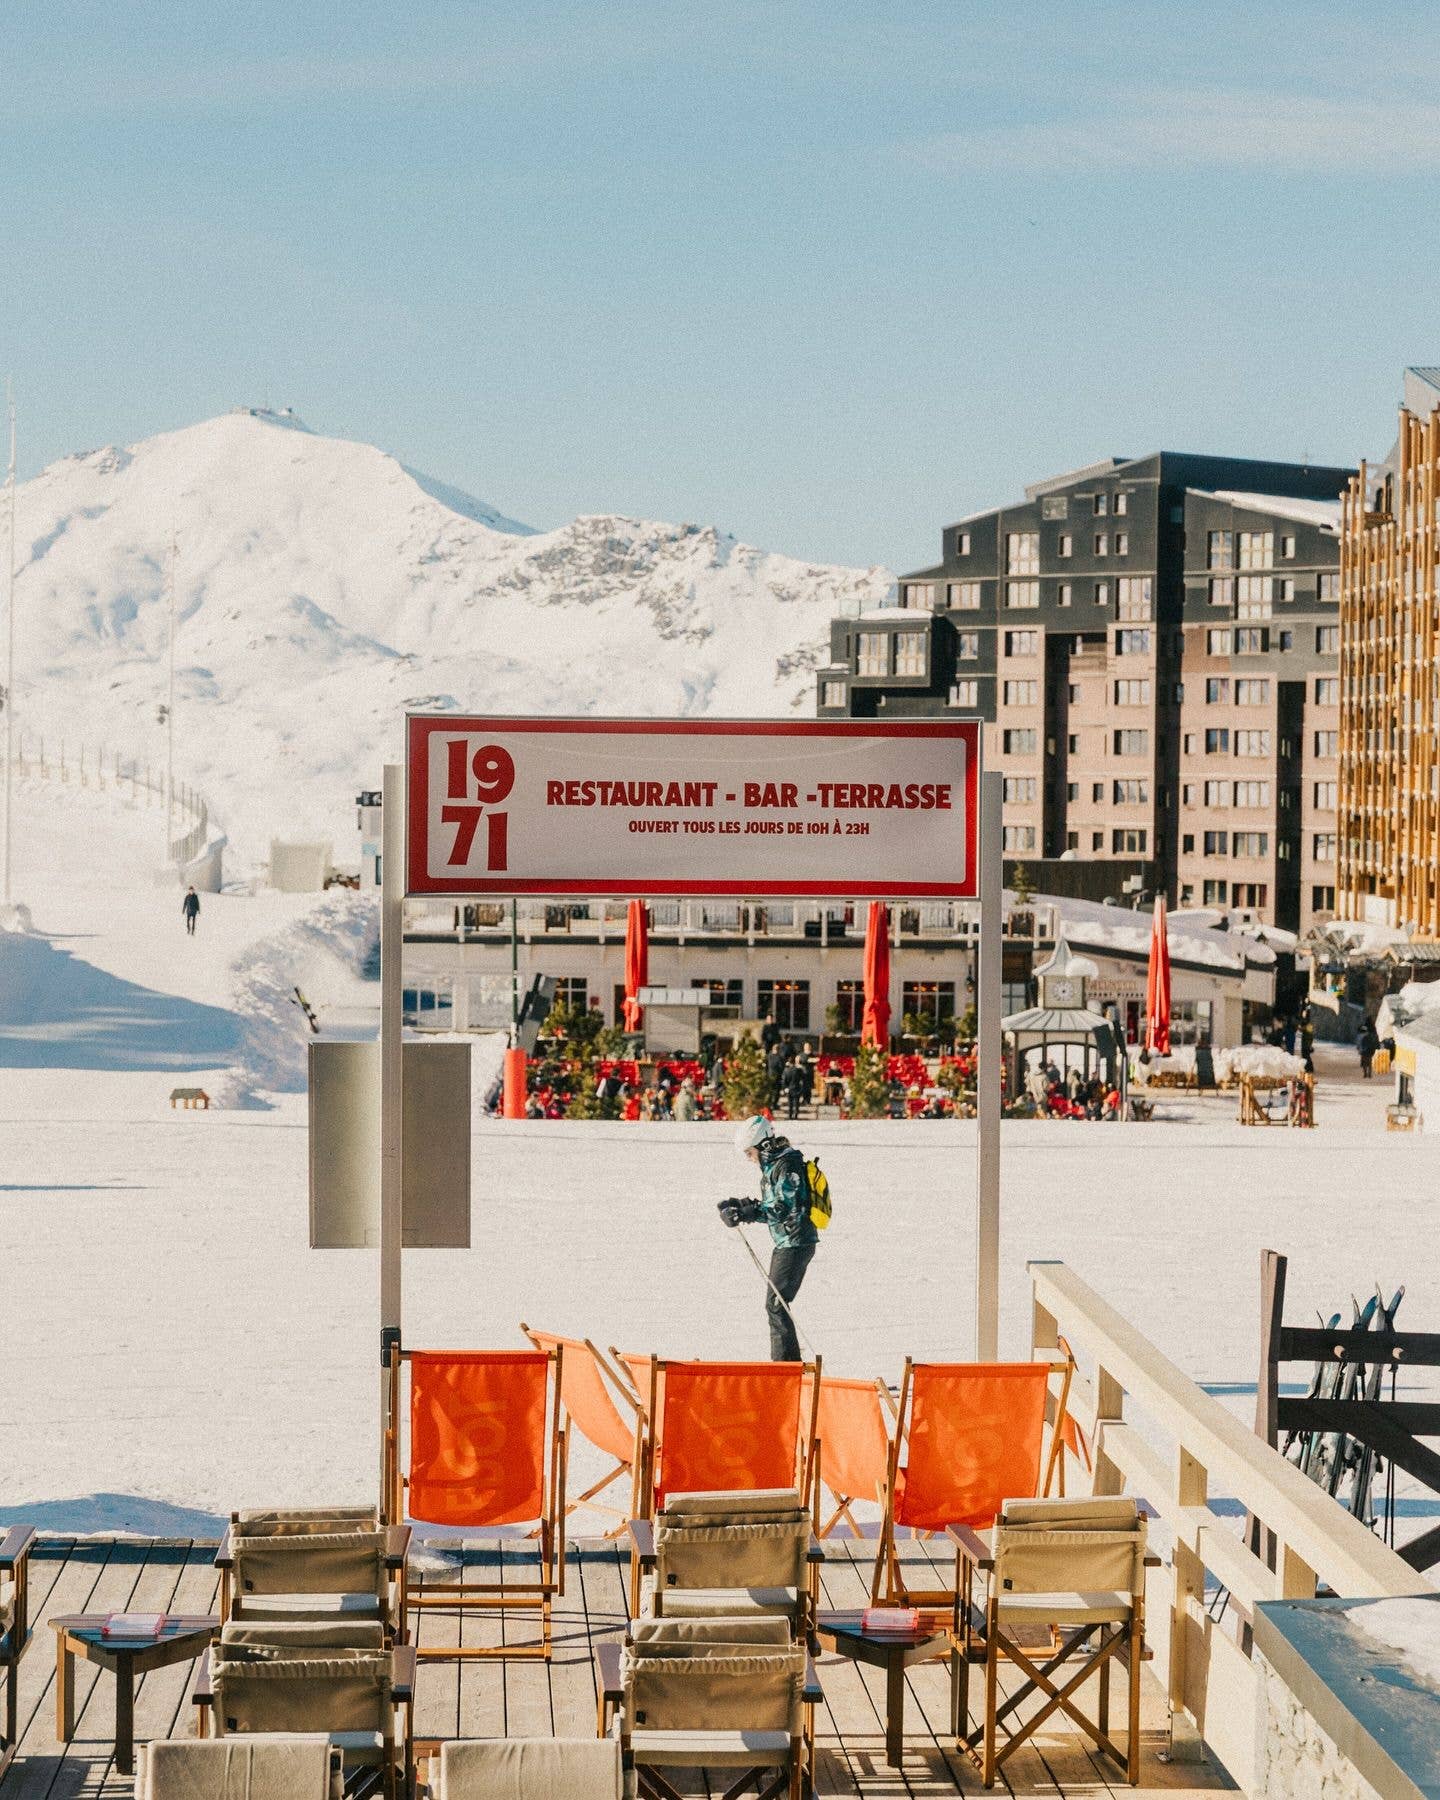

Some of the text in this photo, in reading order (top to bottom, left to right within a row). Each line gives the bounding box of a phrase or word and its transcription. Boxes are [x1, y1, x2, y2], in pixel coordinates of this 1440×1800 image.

[447, 740, 515, 804] 19
[547, 781, 718, 807] RESTAURANT
[744, 783, 798, 808] BAR
[441, 805, 508, 871] 71
[629, 821, 679, 833] OUVERT
[683, 822, 715, 833] TOUS
[719, 822, 740, 833] LES
[744, 822, 784, 834] JOURS
[788, 823, 803, 834] DE
[833, 819, 842, 834] À
[846, 823, 870, 834] 23H
